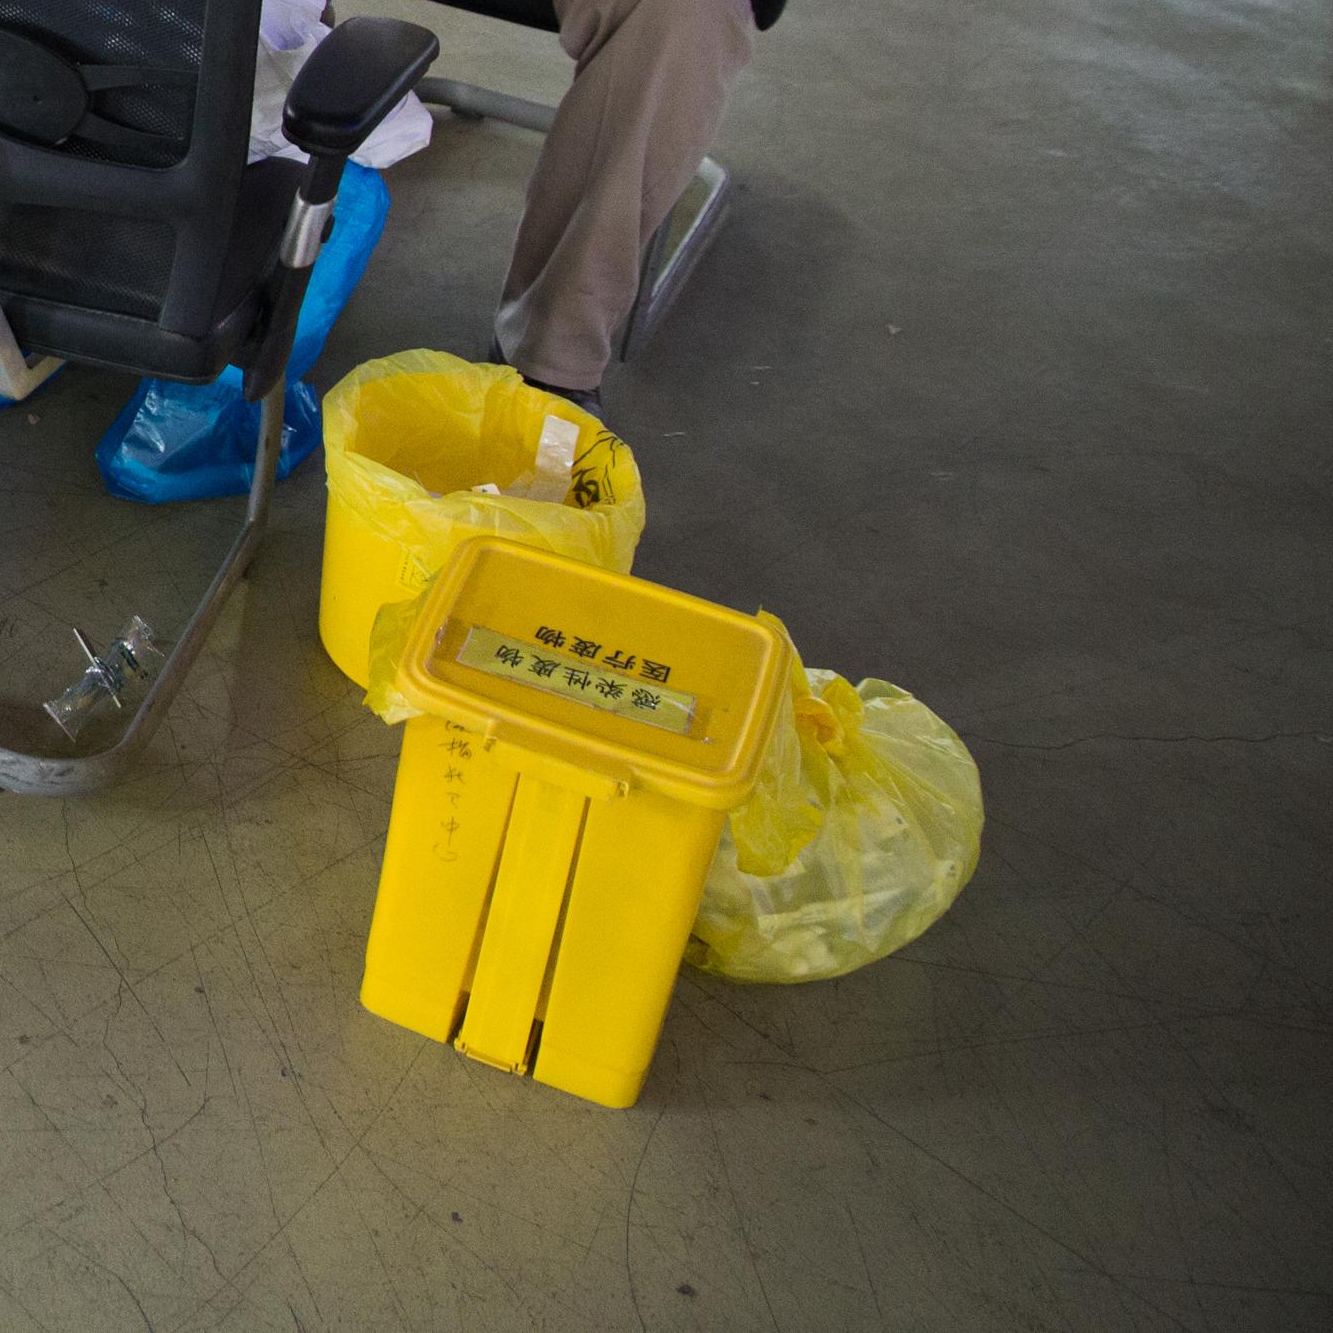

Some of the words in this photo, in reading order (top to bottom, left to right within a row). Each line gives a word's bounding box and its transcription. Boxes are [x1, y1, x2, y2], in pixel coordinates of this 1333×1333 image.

[493, 644, 662, 711] 感染性废物
[534, 626, 672, 683] 医疗废物
